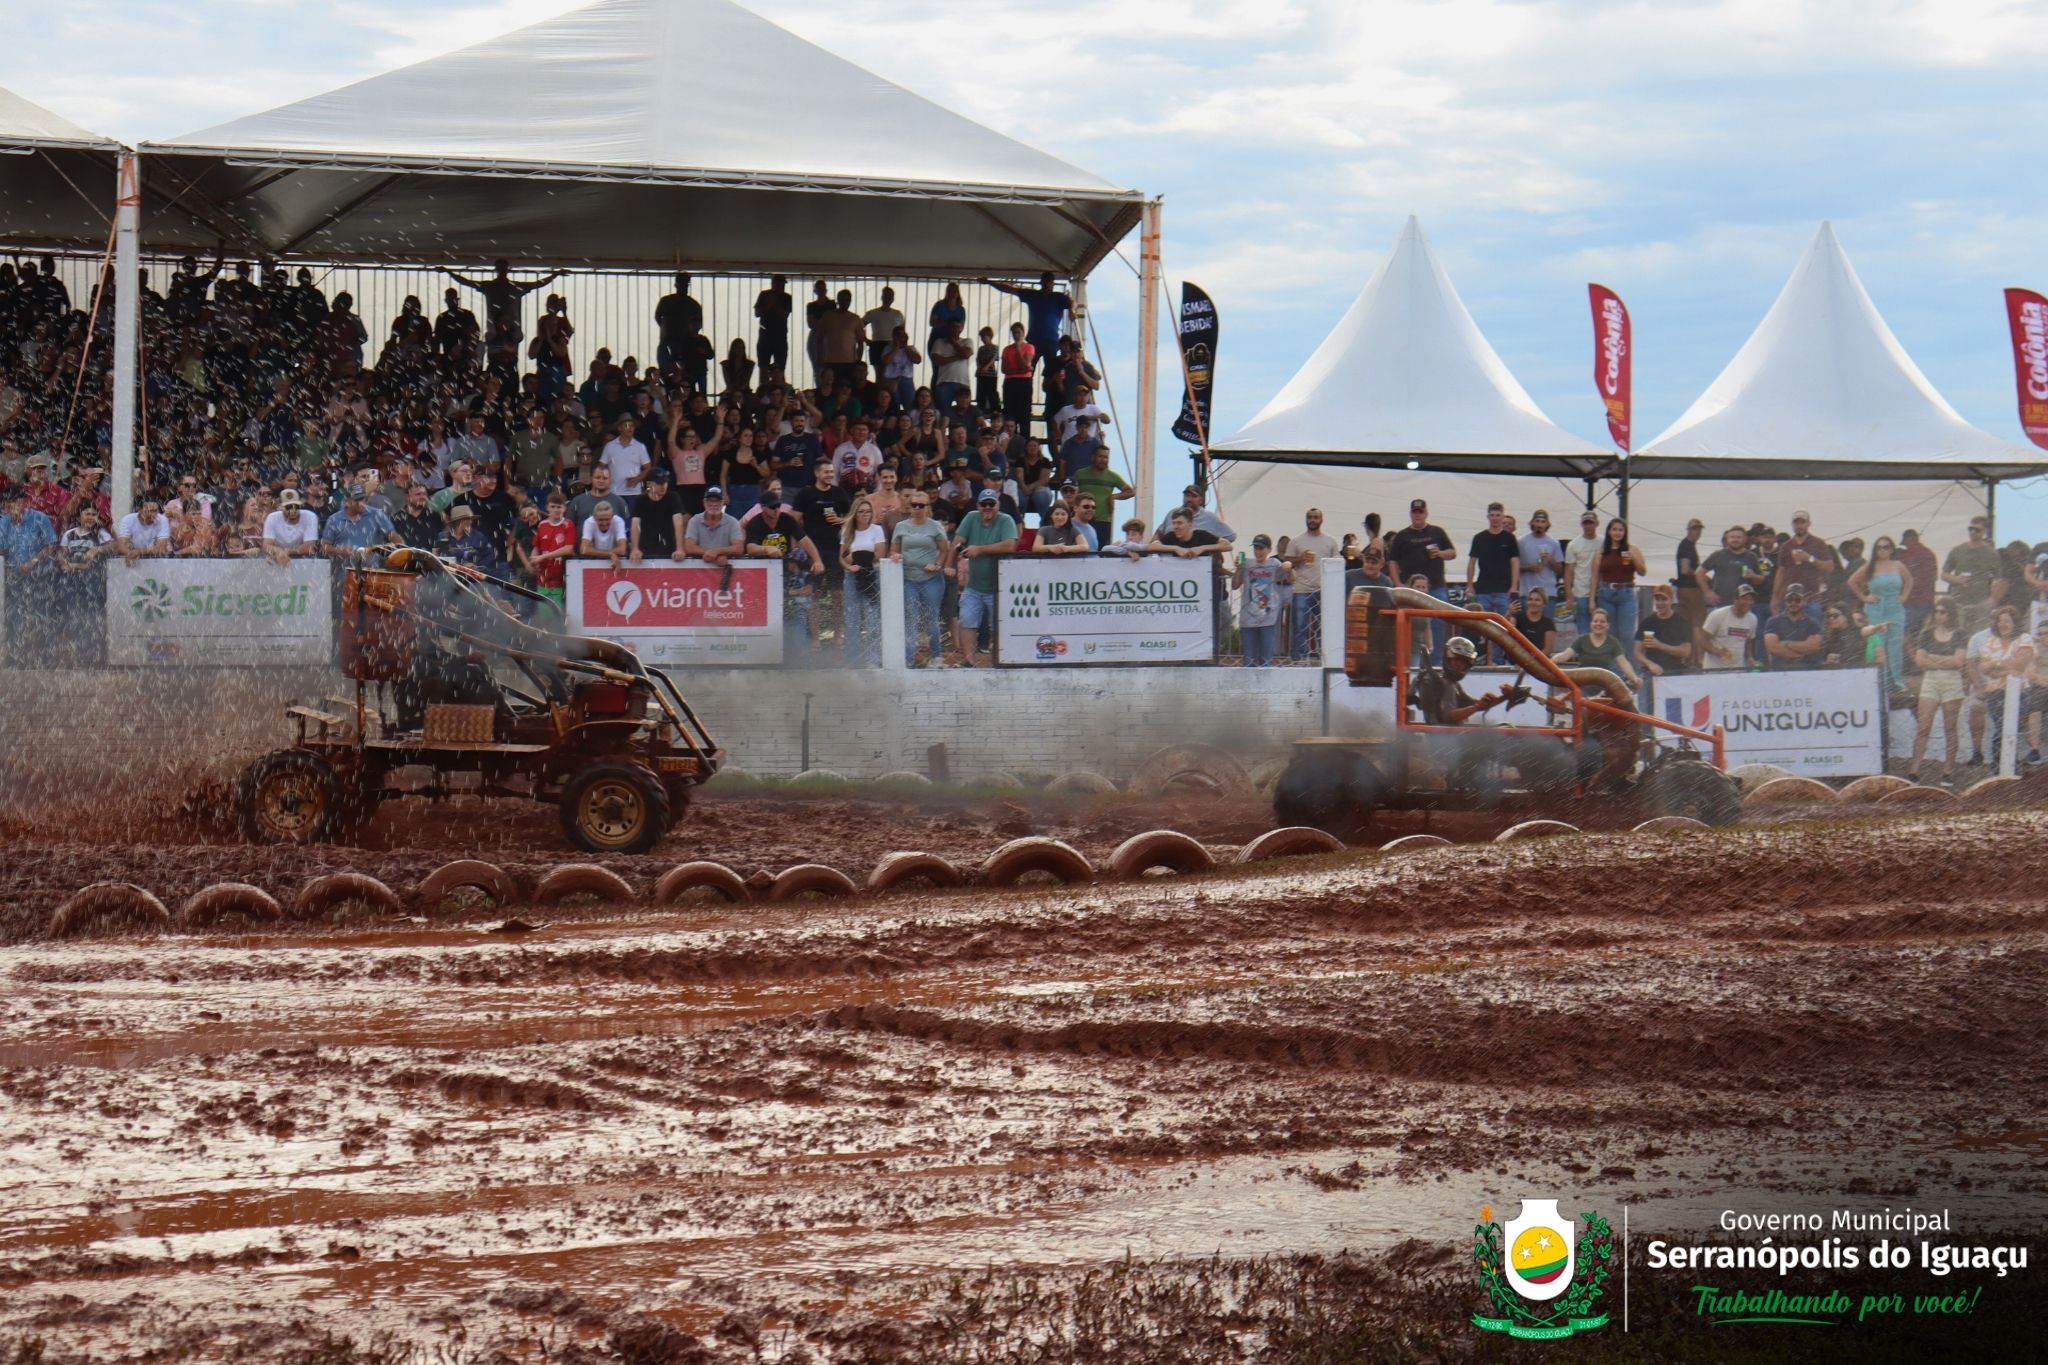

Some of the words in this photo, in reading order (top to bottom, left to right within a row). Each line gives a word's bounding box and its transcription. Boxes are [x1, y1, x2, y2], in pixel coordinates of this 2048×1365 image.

[1182, 300, 1212, 316] ISMAEL
[1180, 316, 1213, 334] EBIDA
[2020, 302, 2047, 400] Colônia
[645, 582, 744, 609] viarnet
[1048, 580, 1198, 601] IRRIGASSOLO
[1448, 589, 1467, 601] EJ
[181, 584, 310, 616] Sicredi
[703, 609, 744, 620] telecom
[1049, 606, 1097, 616] SISTEMAS
[1100, 606, 1113, 615] DE
[1115, 603, 1170, 616] IRRIGAÇÃO
[1722, 697, 1814, 710] FACULDADE
[1723, 710, 1868, 734] UNIGUAÇU
